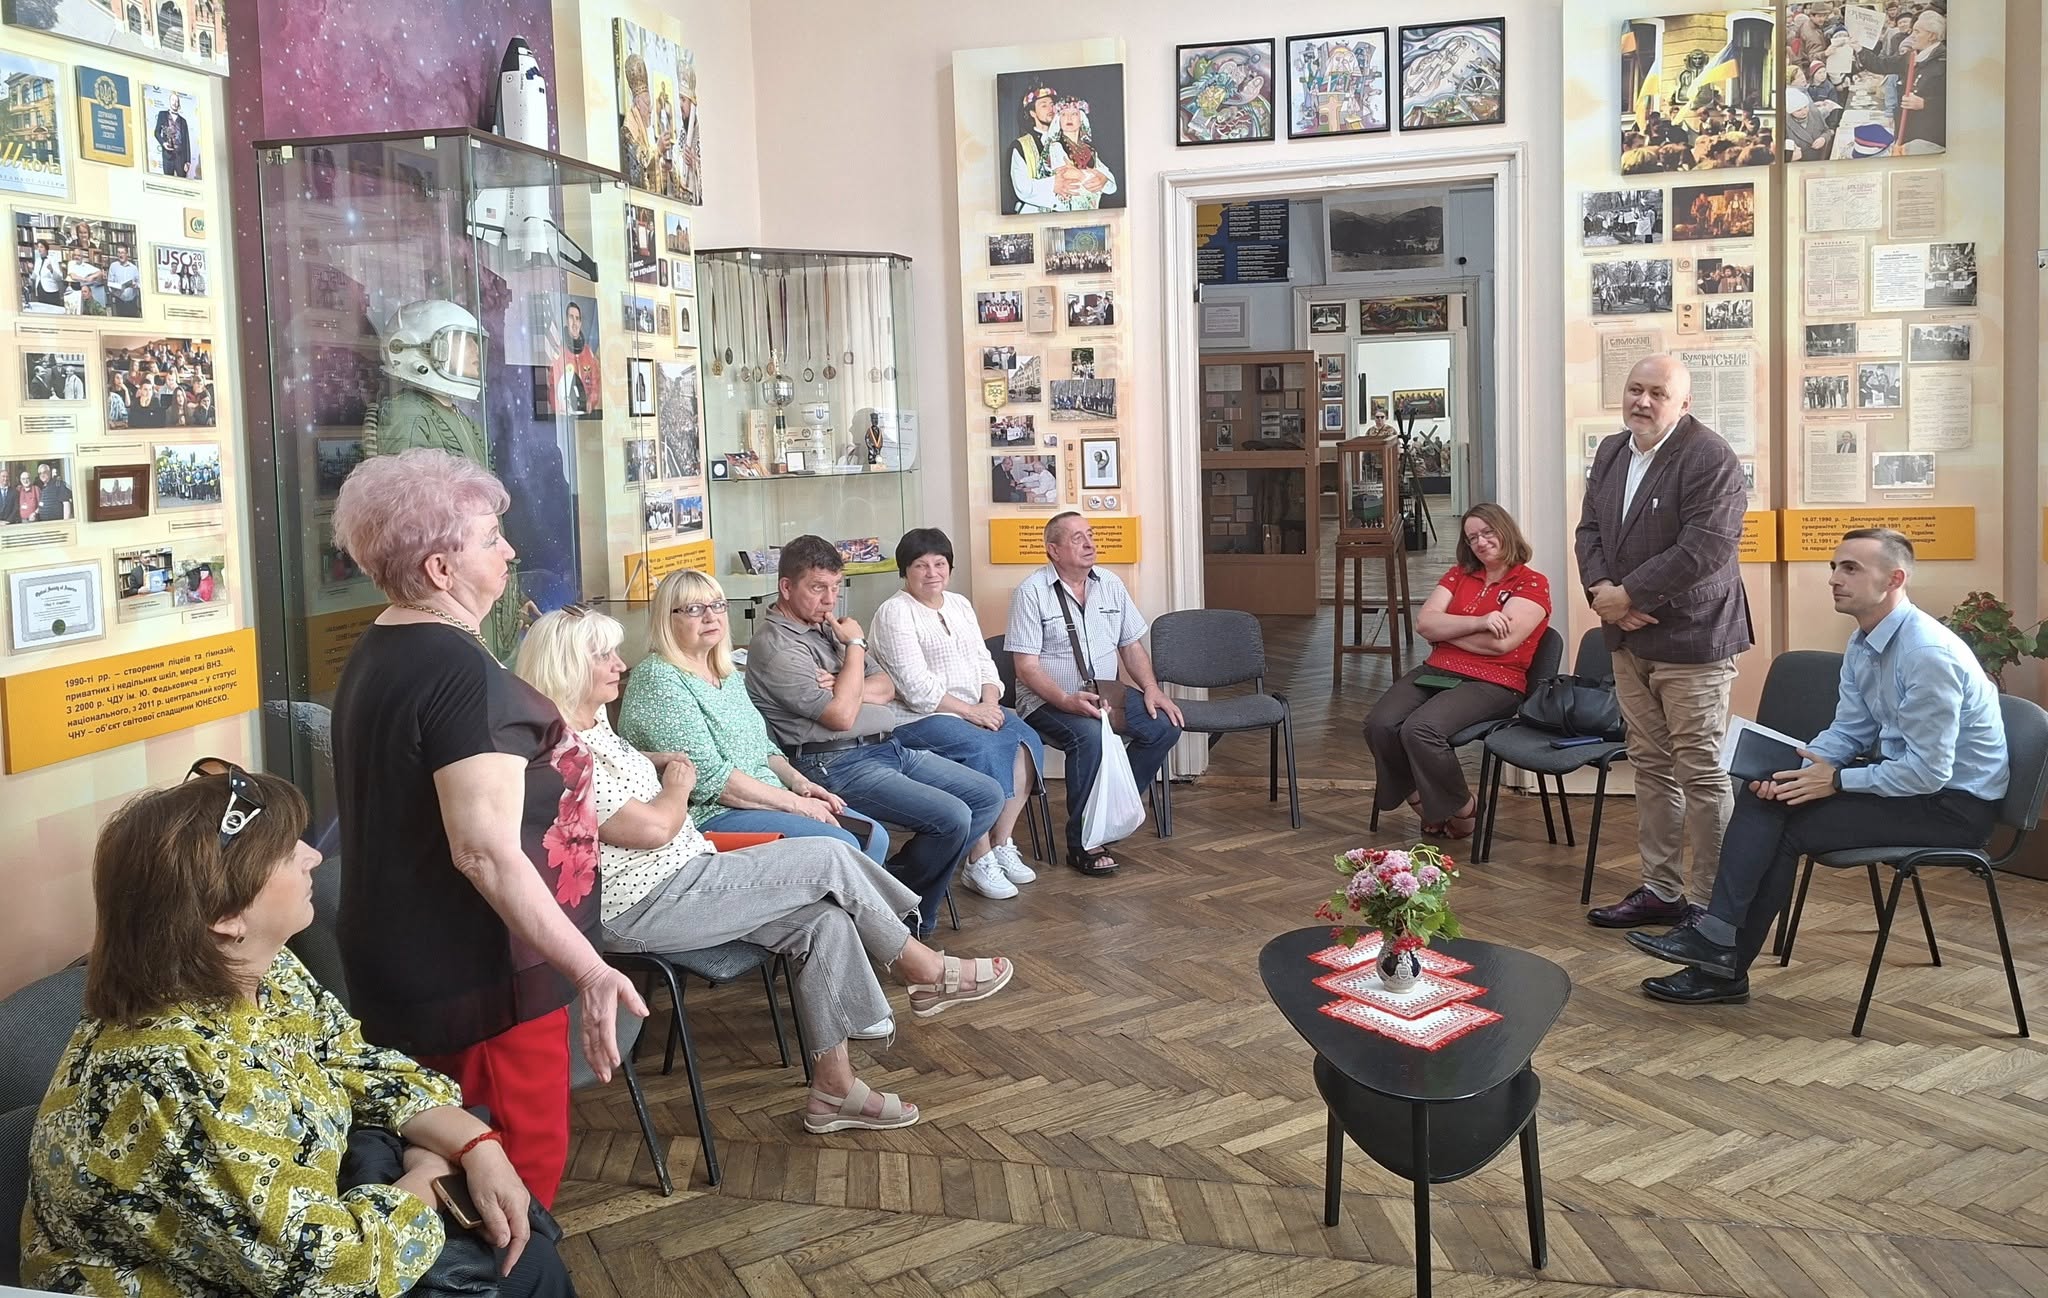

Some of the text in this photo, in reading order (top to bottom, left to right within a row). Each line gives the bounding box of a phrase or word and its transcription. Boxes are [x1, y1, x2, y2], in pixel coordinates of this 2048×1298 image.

[158, 248, 192, 266] IJSO
[65, 675, 94, 688] 1990-ті
[98, 674, 110, 682] рр.
[124, 662, 164, 676] створення
[168, 656, 190, 667] ліцеїв
[206, 645, 235, 657] гімназій,
[66, 687, 110, 702] приватних
[117, 676, 157, 690] недільних
[159, 671, 178, 680] шкіл,
[180, 664, 205, 676] мережі
[207, 660, 223, 669] ВНЗ.
[68, 708, 131, 727] національного,
[138, 700, 154, 710] 2011
[165, 685, 212, 704] центральний
[214, 681, 237, 693] корпус
[75, 702, 94, 712] 2000
[107, 695, 123, 705] ЧДУ
[140, 689, 149, 697] Ю.
[152, 679, 197, 694] Федьковича
[212, 668, 236, 680] статусі
[69, 729, 86, 739] ЧНУ
[123, 713, 154, 726] світової
[157, 704, 194, 718] спадщини
[196, 694, 229, 708] ЮНЕСКО.
